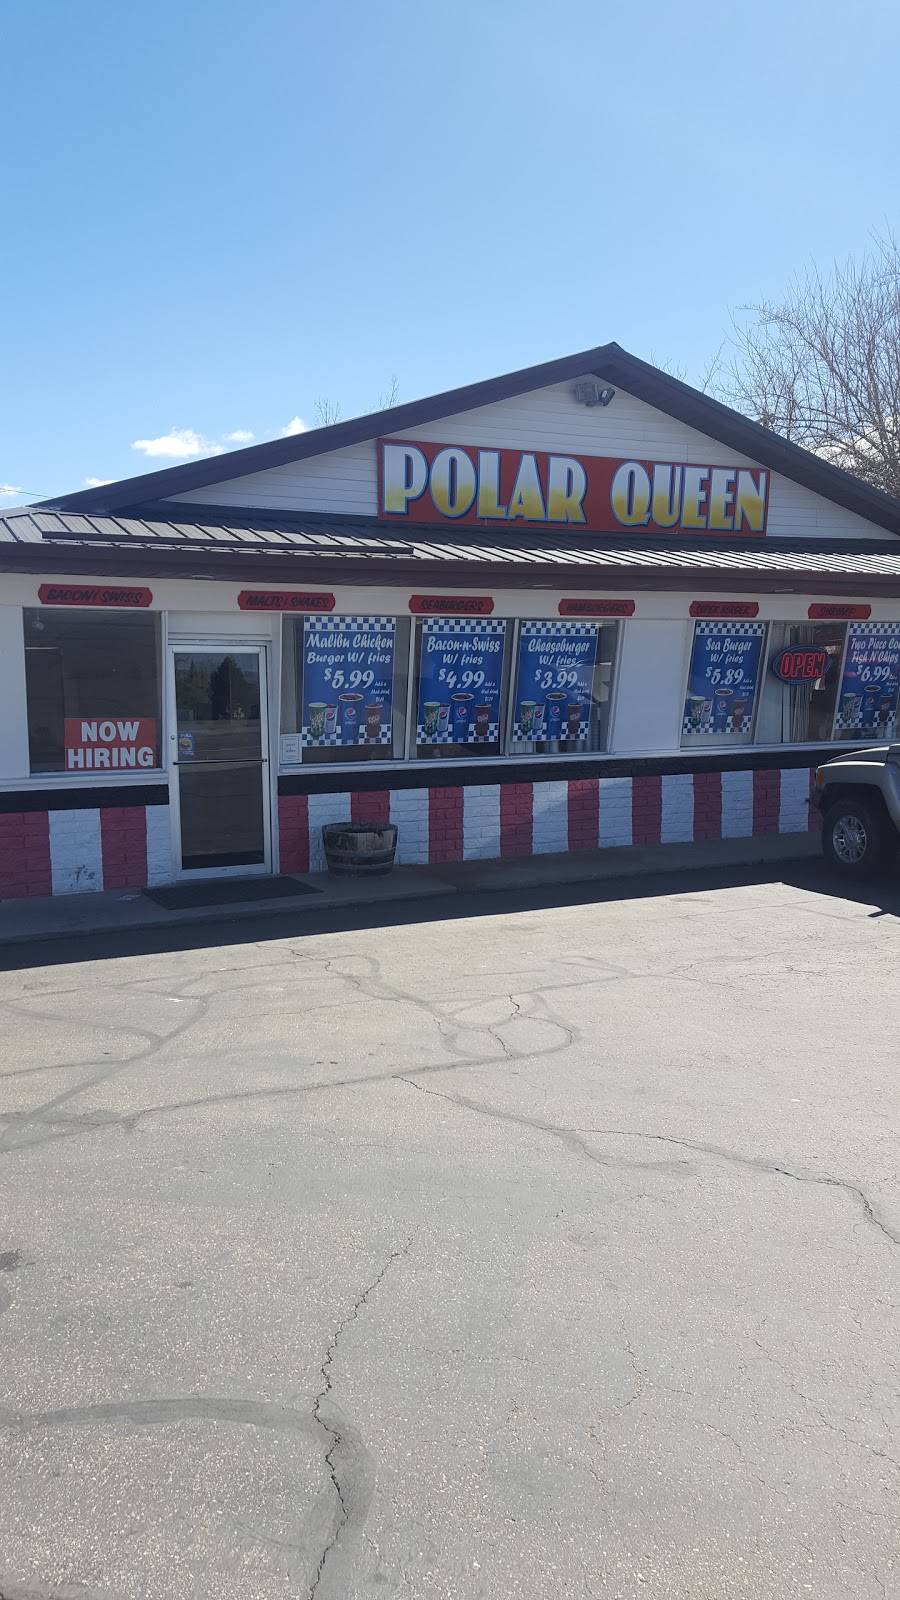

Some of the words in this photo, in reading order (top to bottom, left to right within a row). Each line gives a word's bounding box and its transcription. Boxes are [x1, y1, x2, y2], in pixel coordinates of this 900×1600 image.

[382, 444, 588, 525] POLAR
[610, 460, 766, 533] QUEEN
[306, 633, 350, 648] Malibu
[352, 634, 393, 651] Chicken
[527, 638, 590, 656] Cheeseburger
[705, 638, 721, 651] Sea
[722, 638, 752, 654] Burger
[850, 637, 866, 650] Two
[867, 637, 888, 650] Piece
[306, 652, 345, 665] Burger
[347, 652, 365, 663] W/
[367, 652, 391, 664] fries
[443, 653, 458, 664] W/
[460, 654, 484, 666] fries
[539, 655, 554, 665] W/
[556, 655, 578, 668] fries
[725, 653, 744, 664] fries
[780, 652, 826, 678] OPEN
[851, 651, 868, 664] Fish
[878, 651, 899, 665] Chips
[324, 668, 375, 689] $5.99
[438, 668, 485, 689] $4.99
[534, 669, 578, 689] $3.99
[705, 666, 744, 685] $5.89
[856, 664, 891, 682] $6.99
[81, 721, 140, 742] NOW
[67, 746, 154, 769] HIRING
